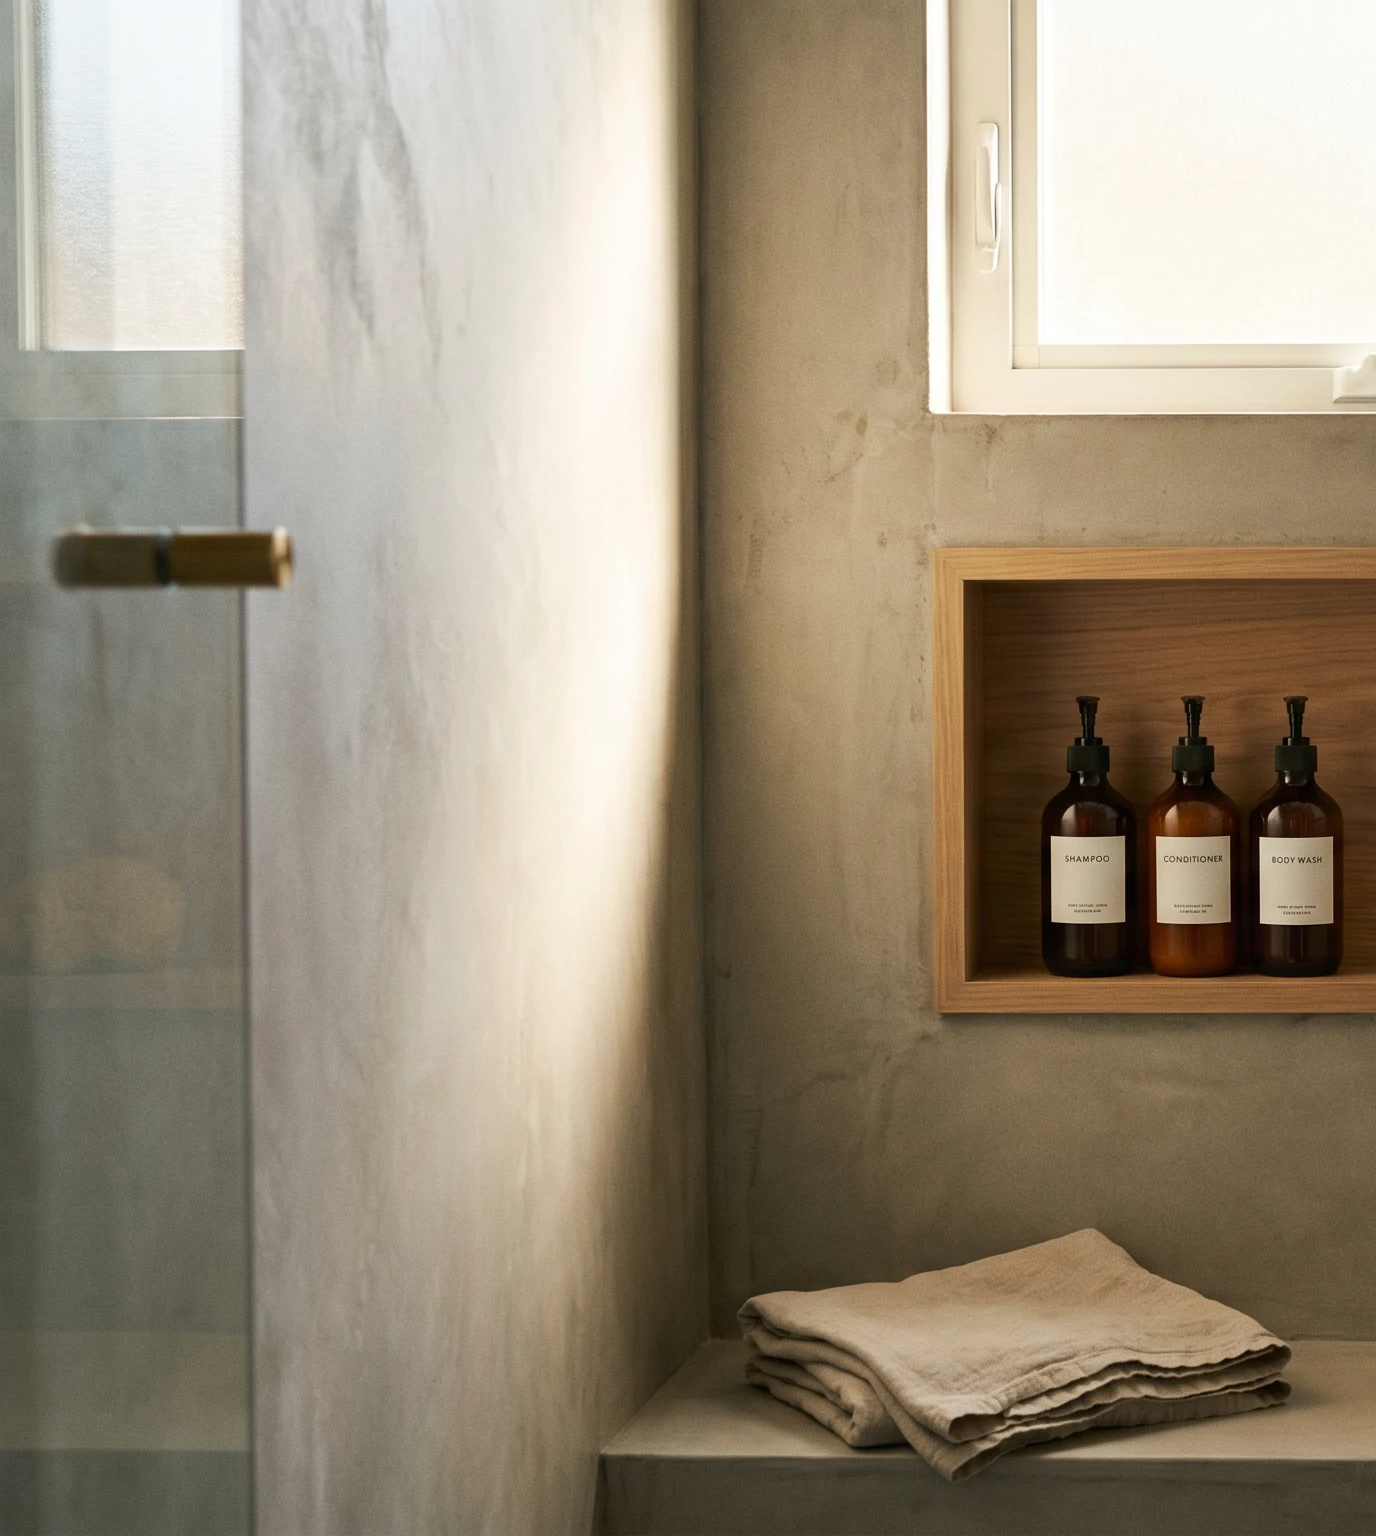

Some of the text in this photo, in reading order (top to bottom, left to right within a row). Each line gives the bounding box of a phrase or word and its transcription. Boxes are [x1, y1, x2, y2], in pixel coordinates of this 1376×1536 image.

[1064, 855, 1110, 863] SHAMPOO
[1163, 855, 1223, 863] CONDITIONER
[1271, 856, 1323, 864] BODY WASH
